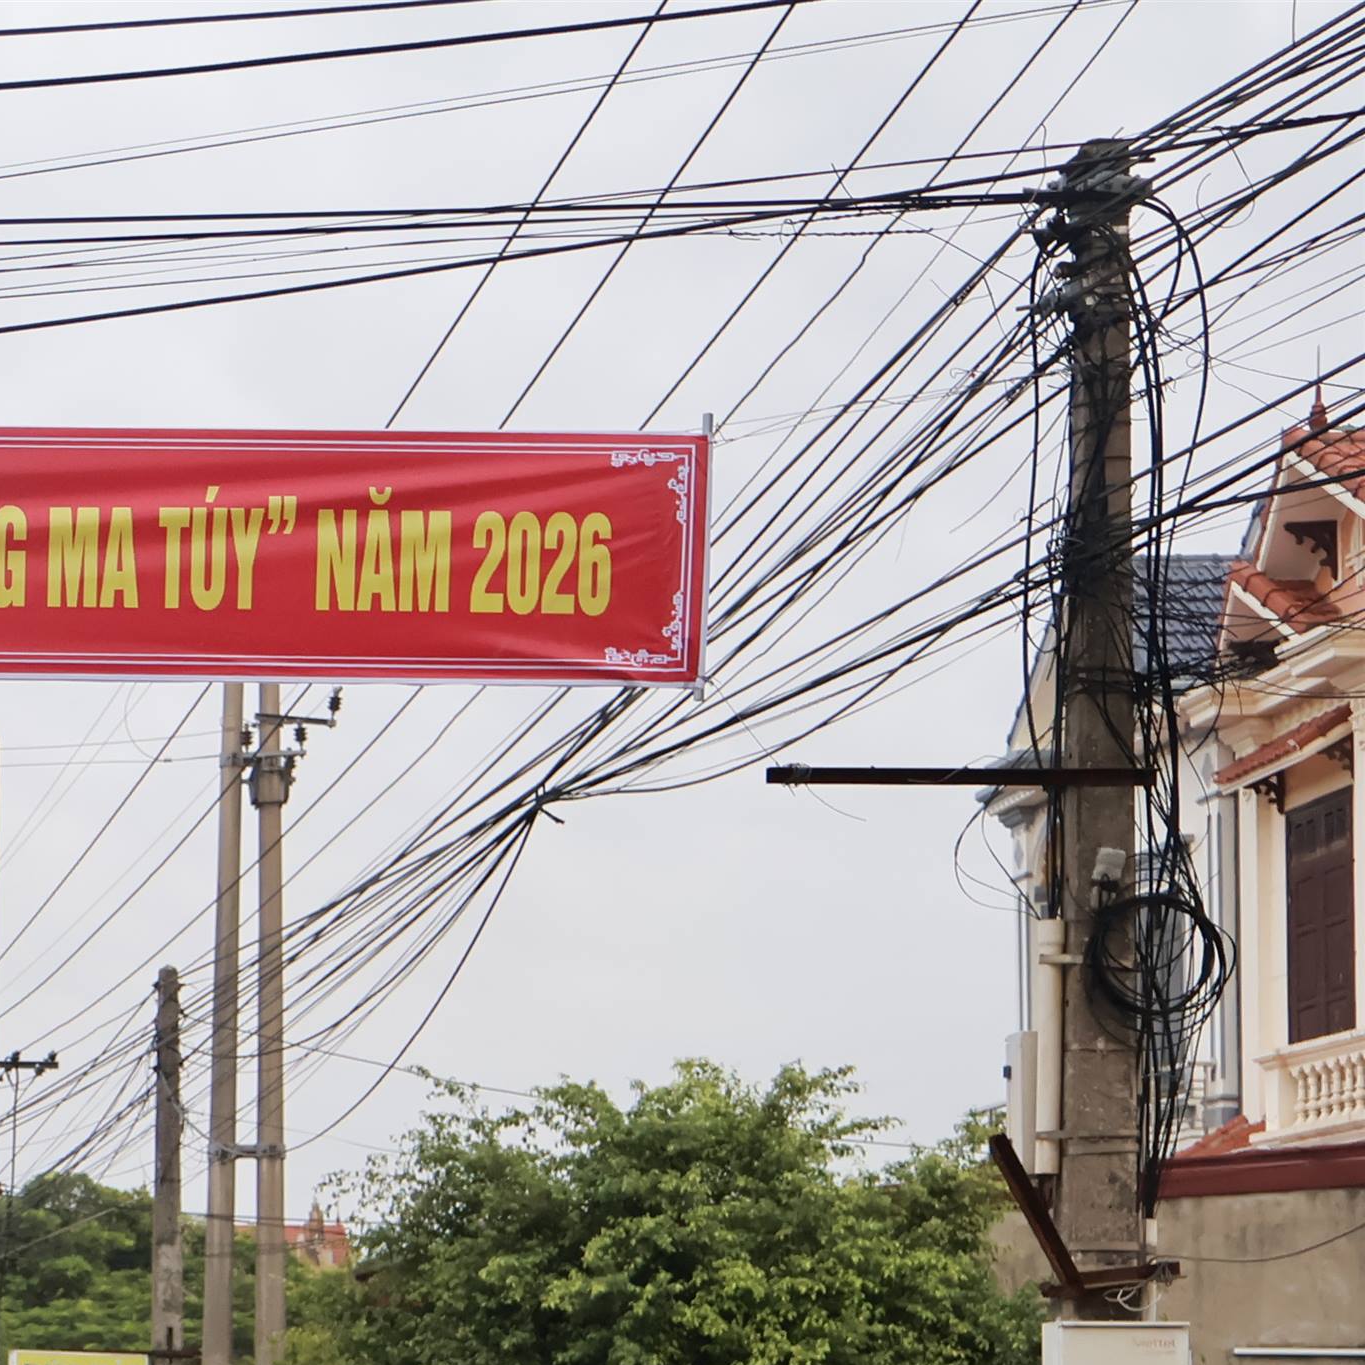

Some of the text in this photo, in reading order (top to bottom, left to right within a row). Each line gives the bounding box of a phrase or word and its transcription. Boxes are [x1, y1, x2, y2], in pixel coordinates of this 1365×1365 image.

[48, 507, 138, 609] MA
[316, 488, 451, 613] NĂM
[471, 511, 611, 617] 2026
